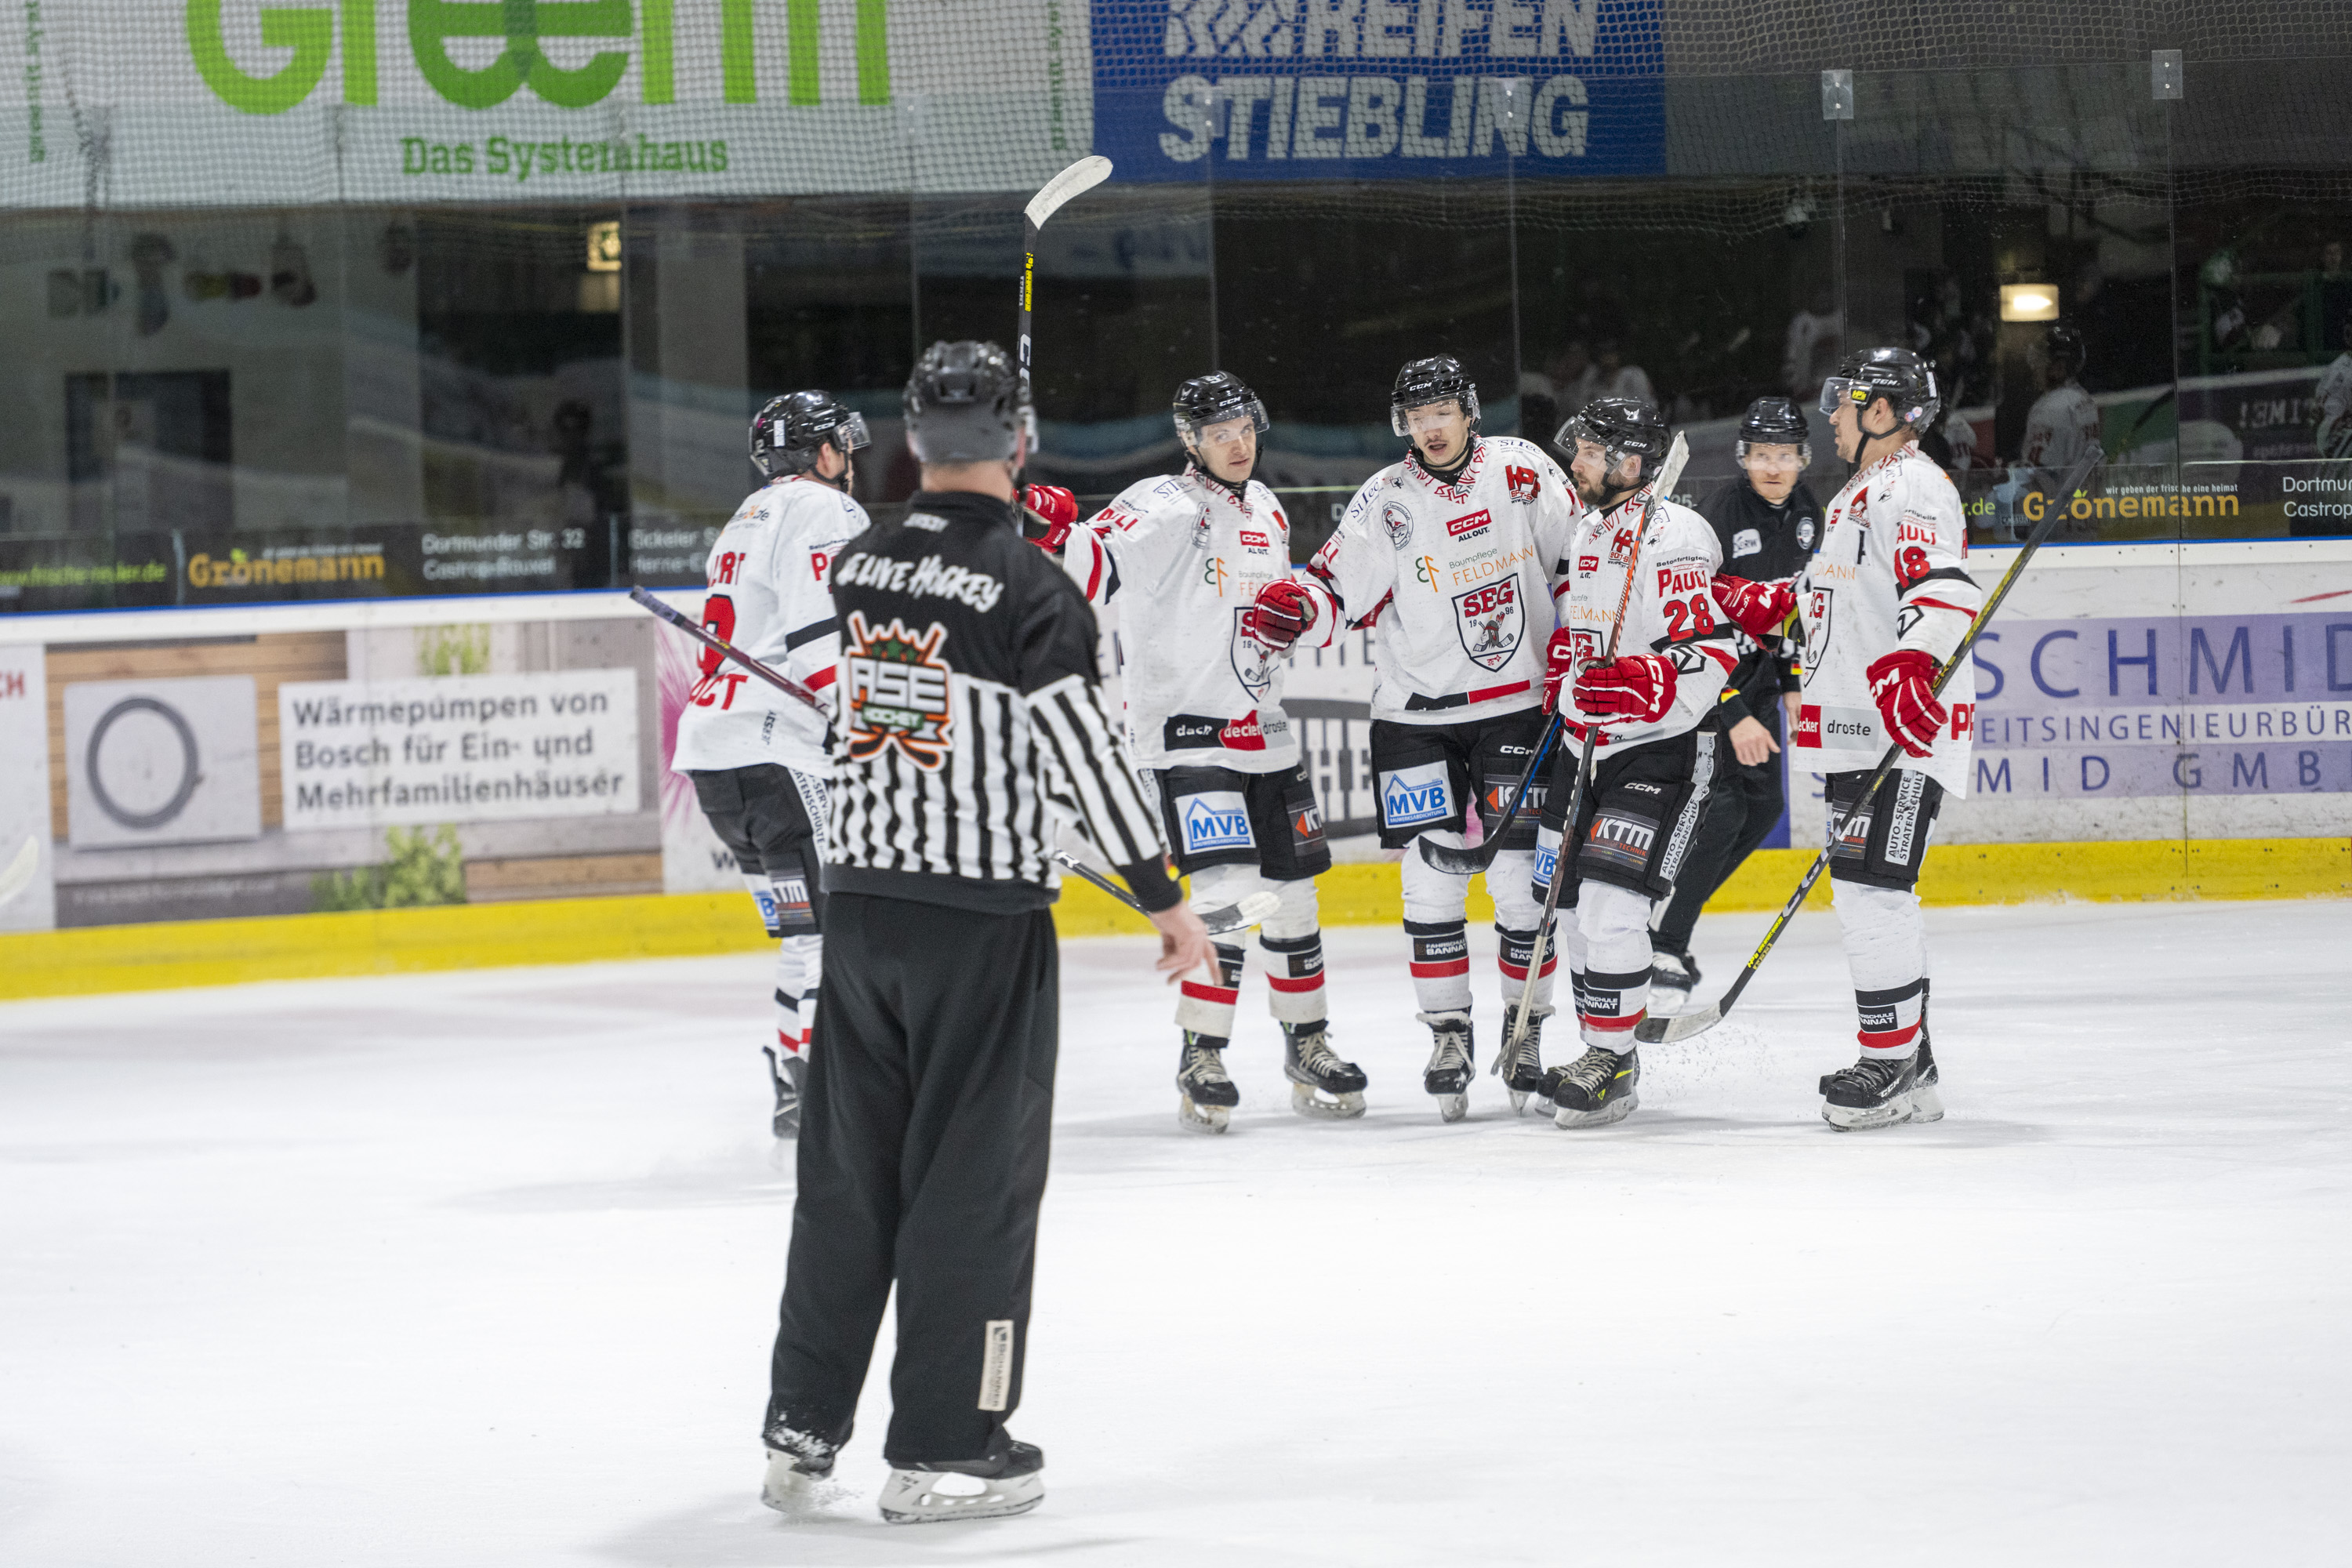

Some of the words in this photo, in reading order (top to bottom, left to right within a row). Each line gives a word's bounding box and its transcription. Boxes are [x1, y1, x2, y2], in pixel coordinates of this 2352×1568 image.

[1298, 0, 1597, 57] REIFEN
[1159, 74, 1589, 162] STIEBLING
[401, 136, 474, 175] Das
[487, 134, 728, 182] Systemhaus
[1410, 382, 1432, 391] CCM
[1219, 396, 1242, 407] CCM
[2106, 486, 2118, 495] wir
[2121, 485, 2143, 496] geben
[2146, 484, 2158, 494] der
[2194, 484, 2209, 494] eine
[2212, 483, 2238, 493] heimat
[1450, 512, 1488, 532] CCM
[1458, 532, 1472, 543] ALL
[1472, 526, 1490, 537] OUT.
[1896, 524, 1936, 545] AULI
[1242, 535, 1268, 544] CCM
[1449, 548, 1497, 569] Baumpflege
[1452, 545, 1534, 586] FELDMANN
[1657, 555, 1710, 568] Betonfertigteile
[1657, 568, 1708, 598] PAULI
[1463, 580, 1515, 619] SEG
[1809, 592, 1825, 619] EG
[1469, 619, 1478, 628] 19
[1505, 606, 1515, 615] 96
[1663, 593, 1715, 643] 28
[292, 695, 538, 730] Wärmepumpen
[549, 691, 608, 715] von
[1981, 704, 2352, 744] EITSINGENIEURBÜR
[1798, 719, 1819, 734] ecker
[1827, 719, 1871, 736] droste
[295, 736, 391, 769] Bosch
[404, 733, 447, 764] für
[461, 731, 519, 763] Ein-
[534, 729, 593, 758] und
[2172, 750, 2352, 790] GMB
[296, 768, 624, 811] Mehrfamilienhäuser
[1388, 786, 1446, 816] MVB
[1624, 782, 1662, 795] CCM
[793, 768, 826, 844] ATENSCHULTE
[1888, 776, 1912, 858] AUTO-SERVICE
[1900, 771, 1925, 860] STRATENSCHULT
[1192, 815, 1249, 840] MVB
[1595, 817, 1655, 851] KTM
[1535, 849, 1556, 876] VB
[1619, 843, 1646, 857] TECHNIK
[1426, 942, 1467, 956] BANNAT
